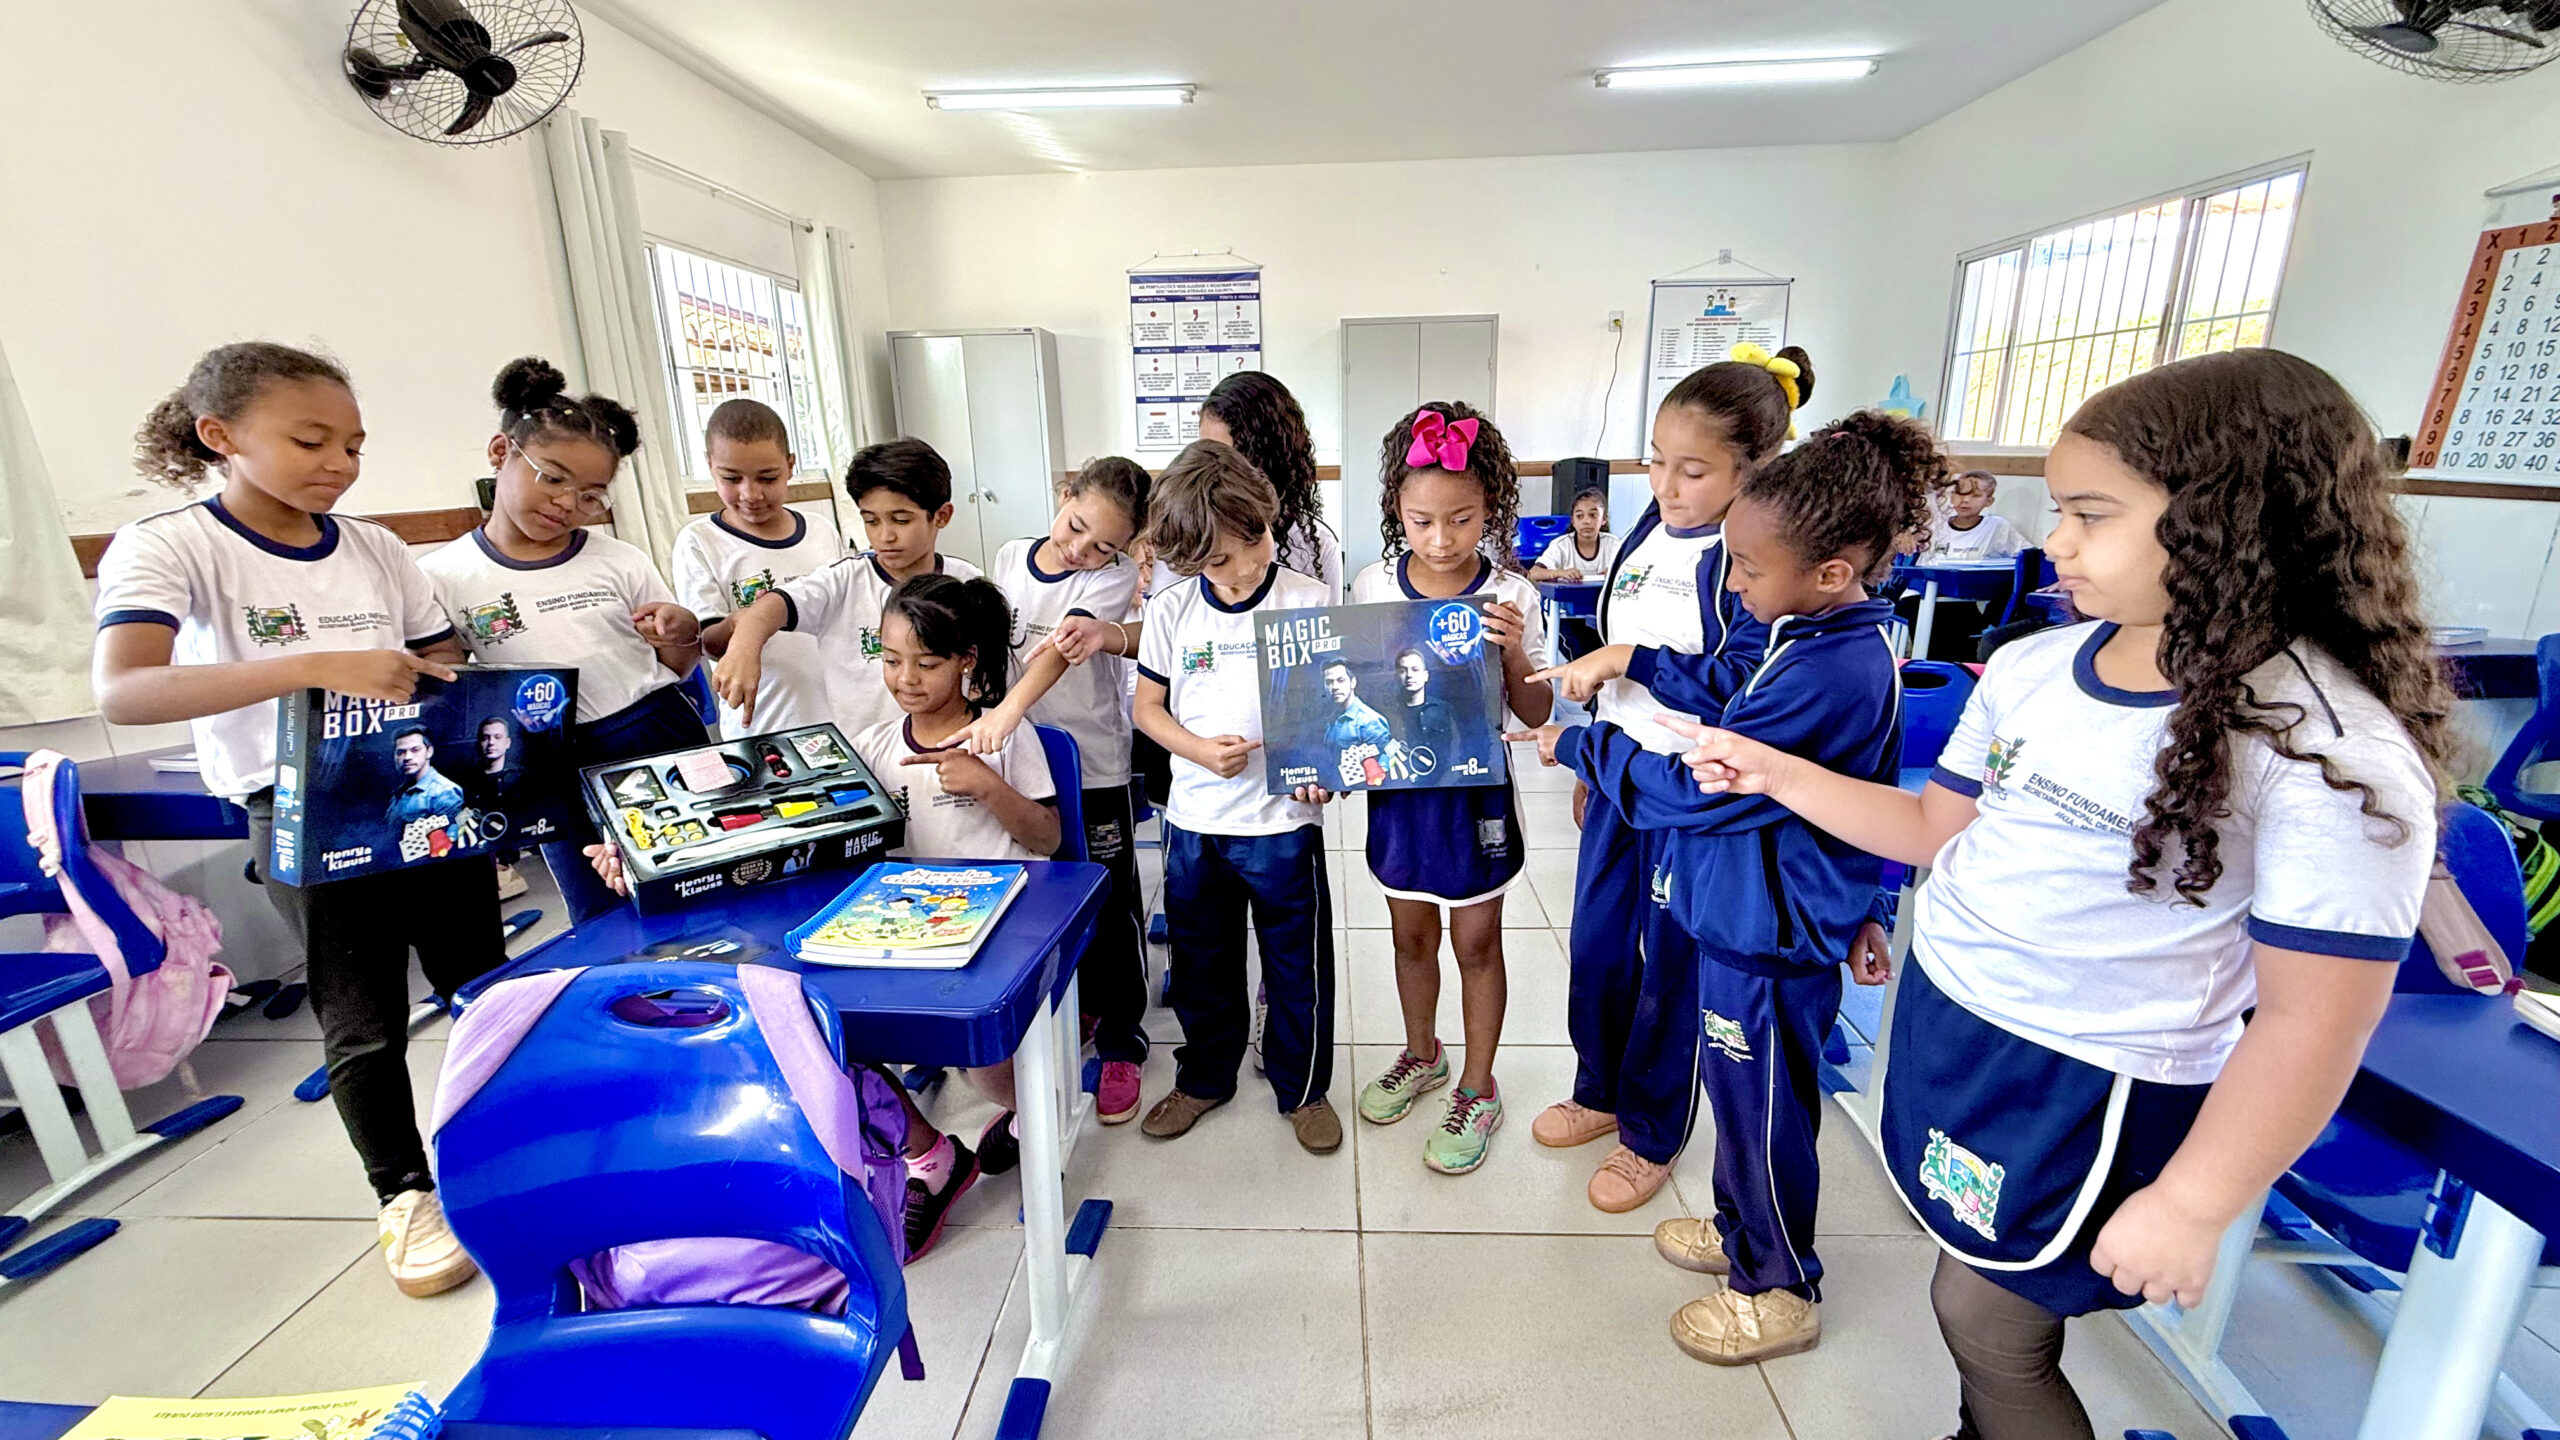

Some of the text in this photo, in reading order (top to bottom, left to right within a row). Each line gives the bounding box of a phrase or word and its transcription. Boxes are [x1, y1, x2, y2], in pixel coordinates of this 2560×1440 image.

[2519, 228, 2527, 244] 1
[2545, 224, 2558, 241] 2
[2484, 248, 2550, 271] 1 1 2
[2474, 272, 2542, 294] 2 2 4
[2467, 301, 2478, 316] 3
[2495, 298, 2506, 314] 3
[2523, 295, 2536, 312] 6
[2460, 316, 2560, 338] 4 4 8 12
[2455, 340, 2557, 360] 5 5 10 15
[2447, 363, 2549, 382] 6 6 12 18
[2440, 386, 2560, 403] 7 7 14 21 2
[2434, 410, 2444, 424] 8
[2460, 409, 2472, 424] 8
[2485, 409, 2505, 425] 16
[2511, 409, 2534, 425] 24
[2426, 430, 2557, 448] 9 9 18 27 36
[2416, 451, 2548, 471] 10 10 20 30 40
[1265, 616, 1330, 646] MAGIC
[1437, 610, 1470, 633] +60
[1268, 639, 1337, 669] BOX PRO
[524, 681, 555, 702] +60
[324, 706, 416, 739] BOX PRO
[1280, 766, 1310, 776] Henry
[1468, 758, 1478, 775] 8
[2022, 784, 2060, 807] SECRETARIA
[2028, 773, 2135, 832] ENSINO FUNDAMEN
[538, 818, 547, 834] 8
[845, 831, 879, 848] MAGIC
[322, 846, 364, 862] Henry
[845, 842, 868, 858] BOX
[675, 874, 714, 891] Henry
